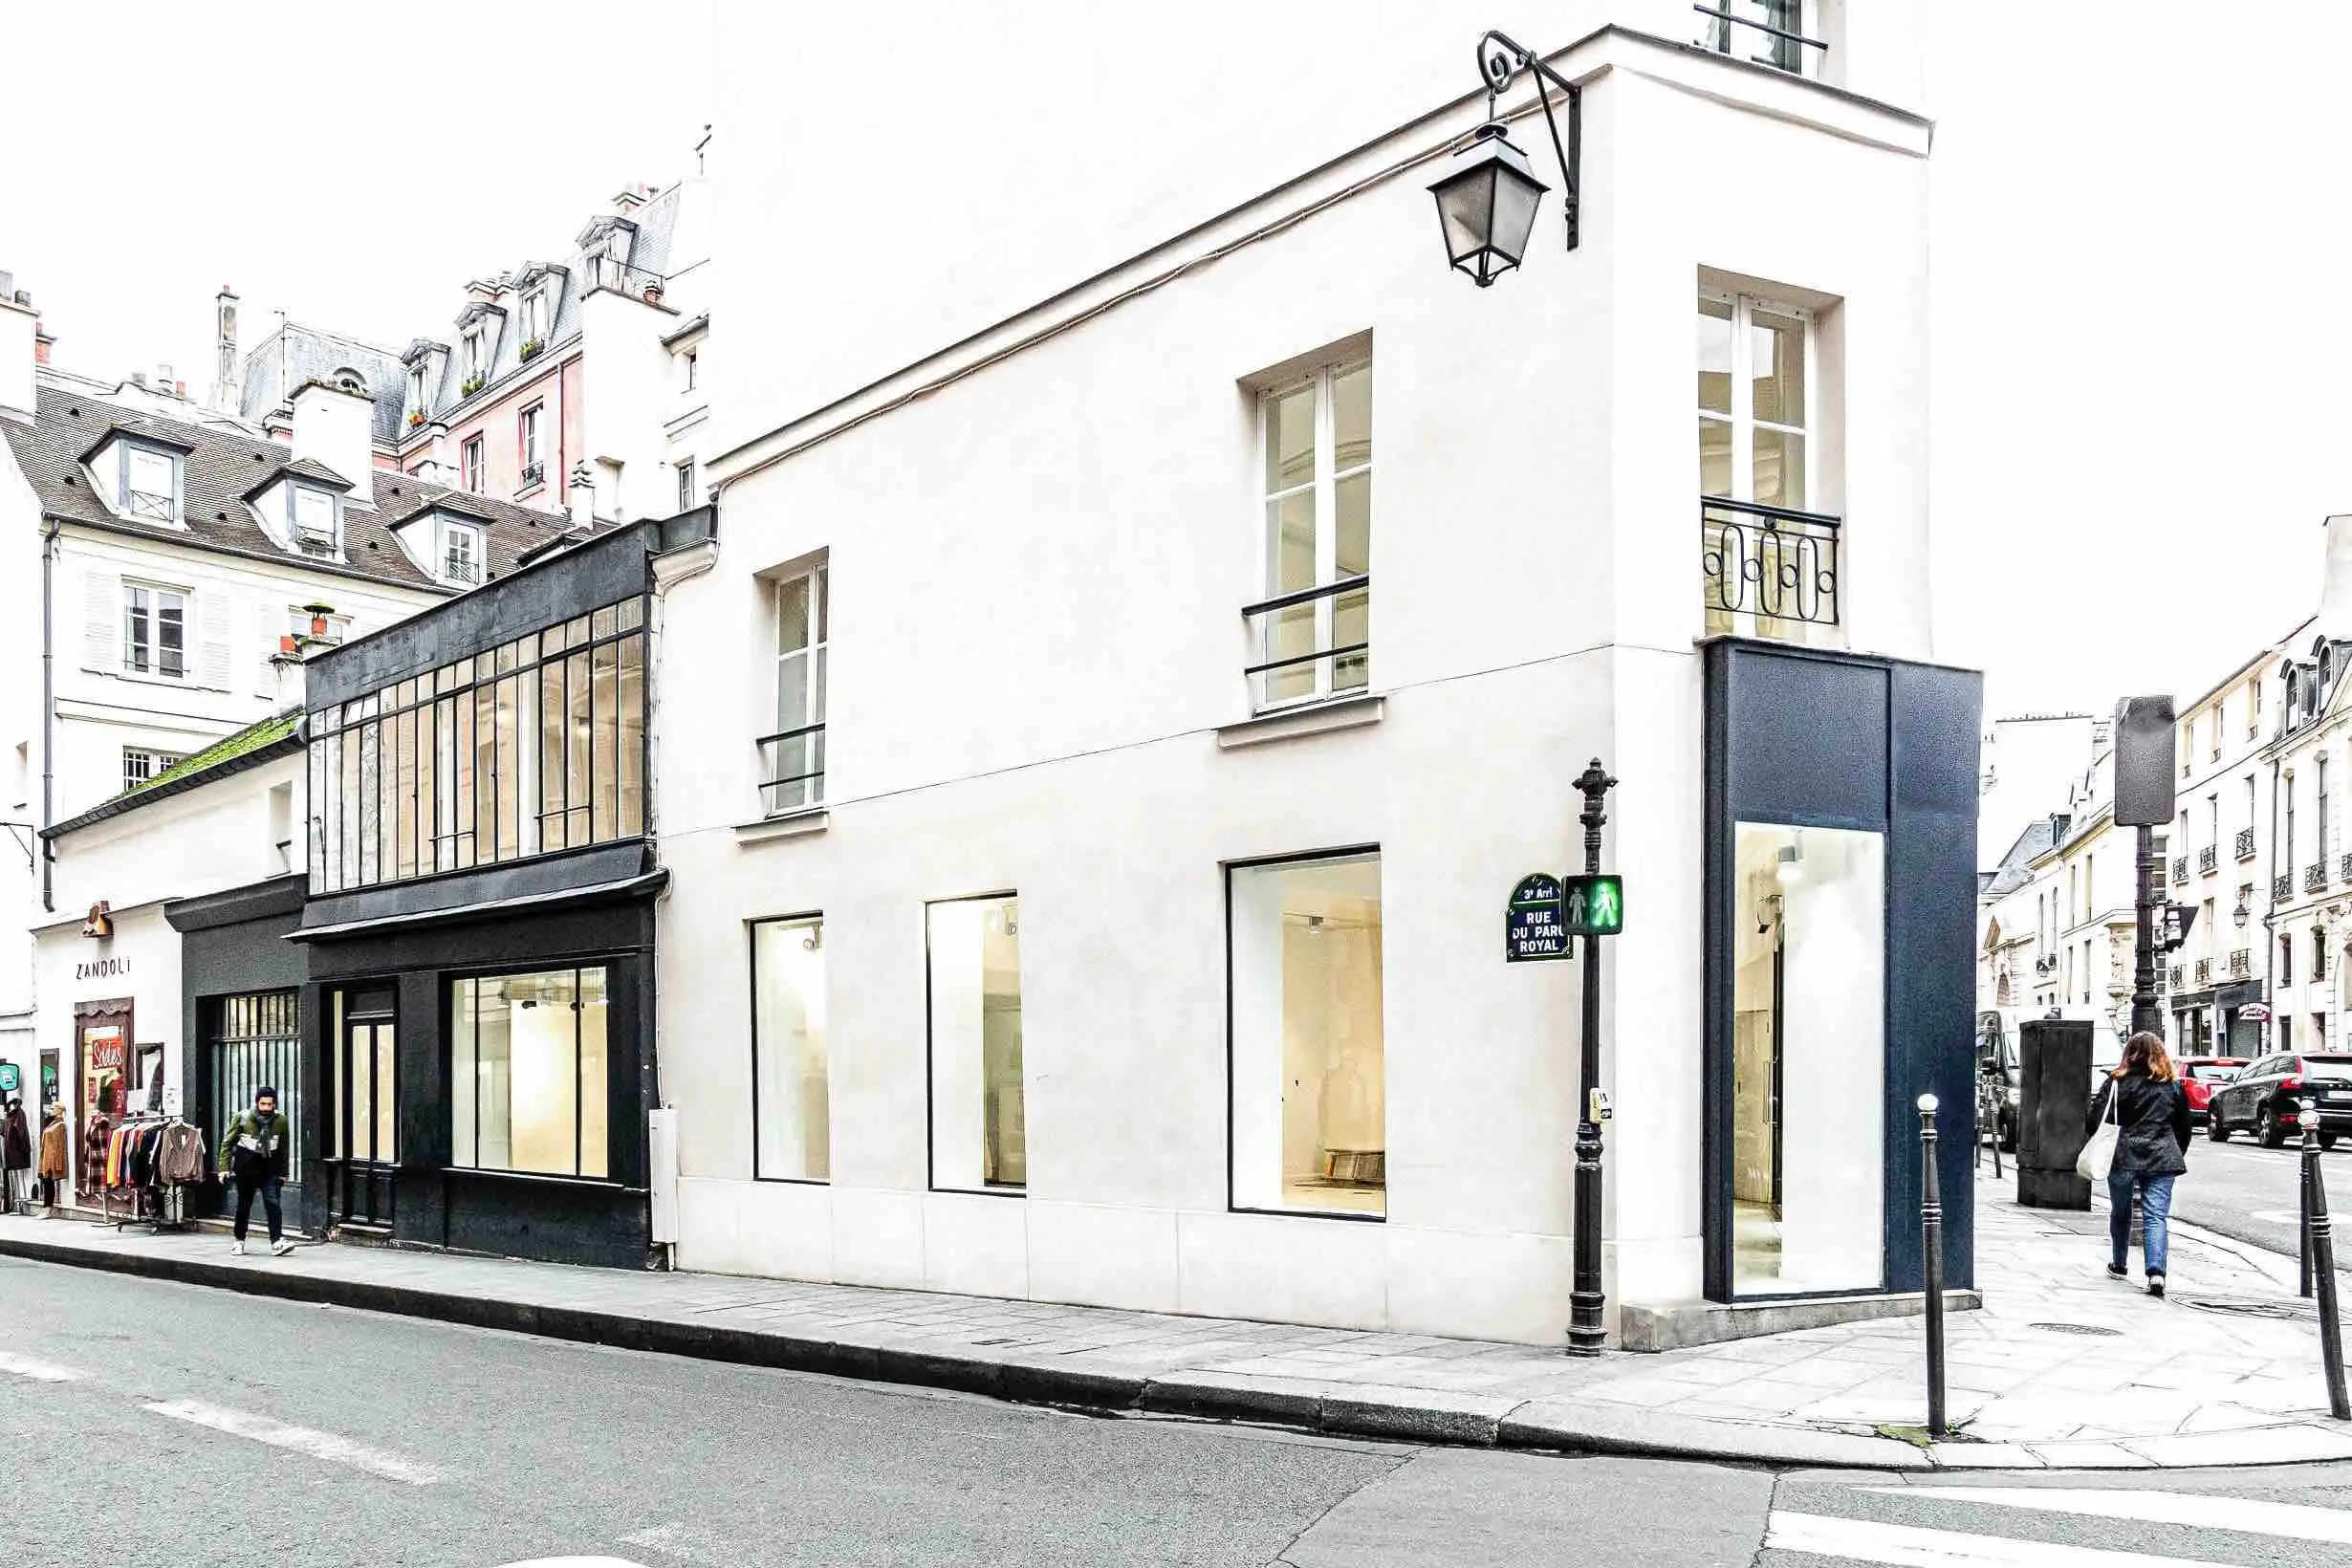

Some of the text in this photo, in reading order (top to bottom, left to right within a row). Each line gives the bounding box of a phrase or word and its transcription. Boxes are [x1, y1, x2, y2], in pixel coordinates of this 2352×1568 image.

[1526, 911, 1551, 925] RUE
[1513, 927, 1528, 939] DU
[1519, 939, 1558, 952] ROYAL
